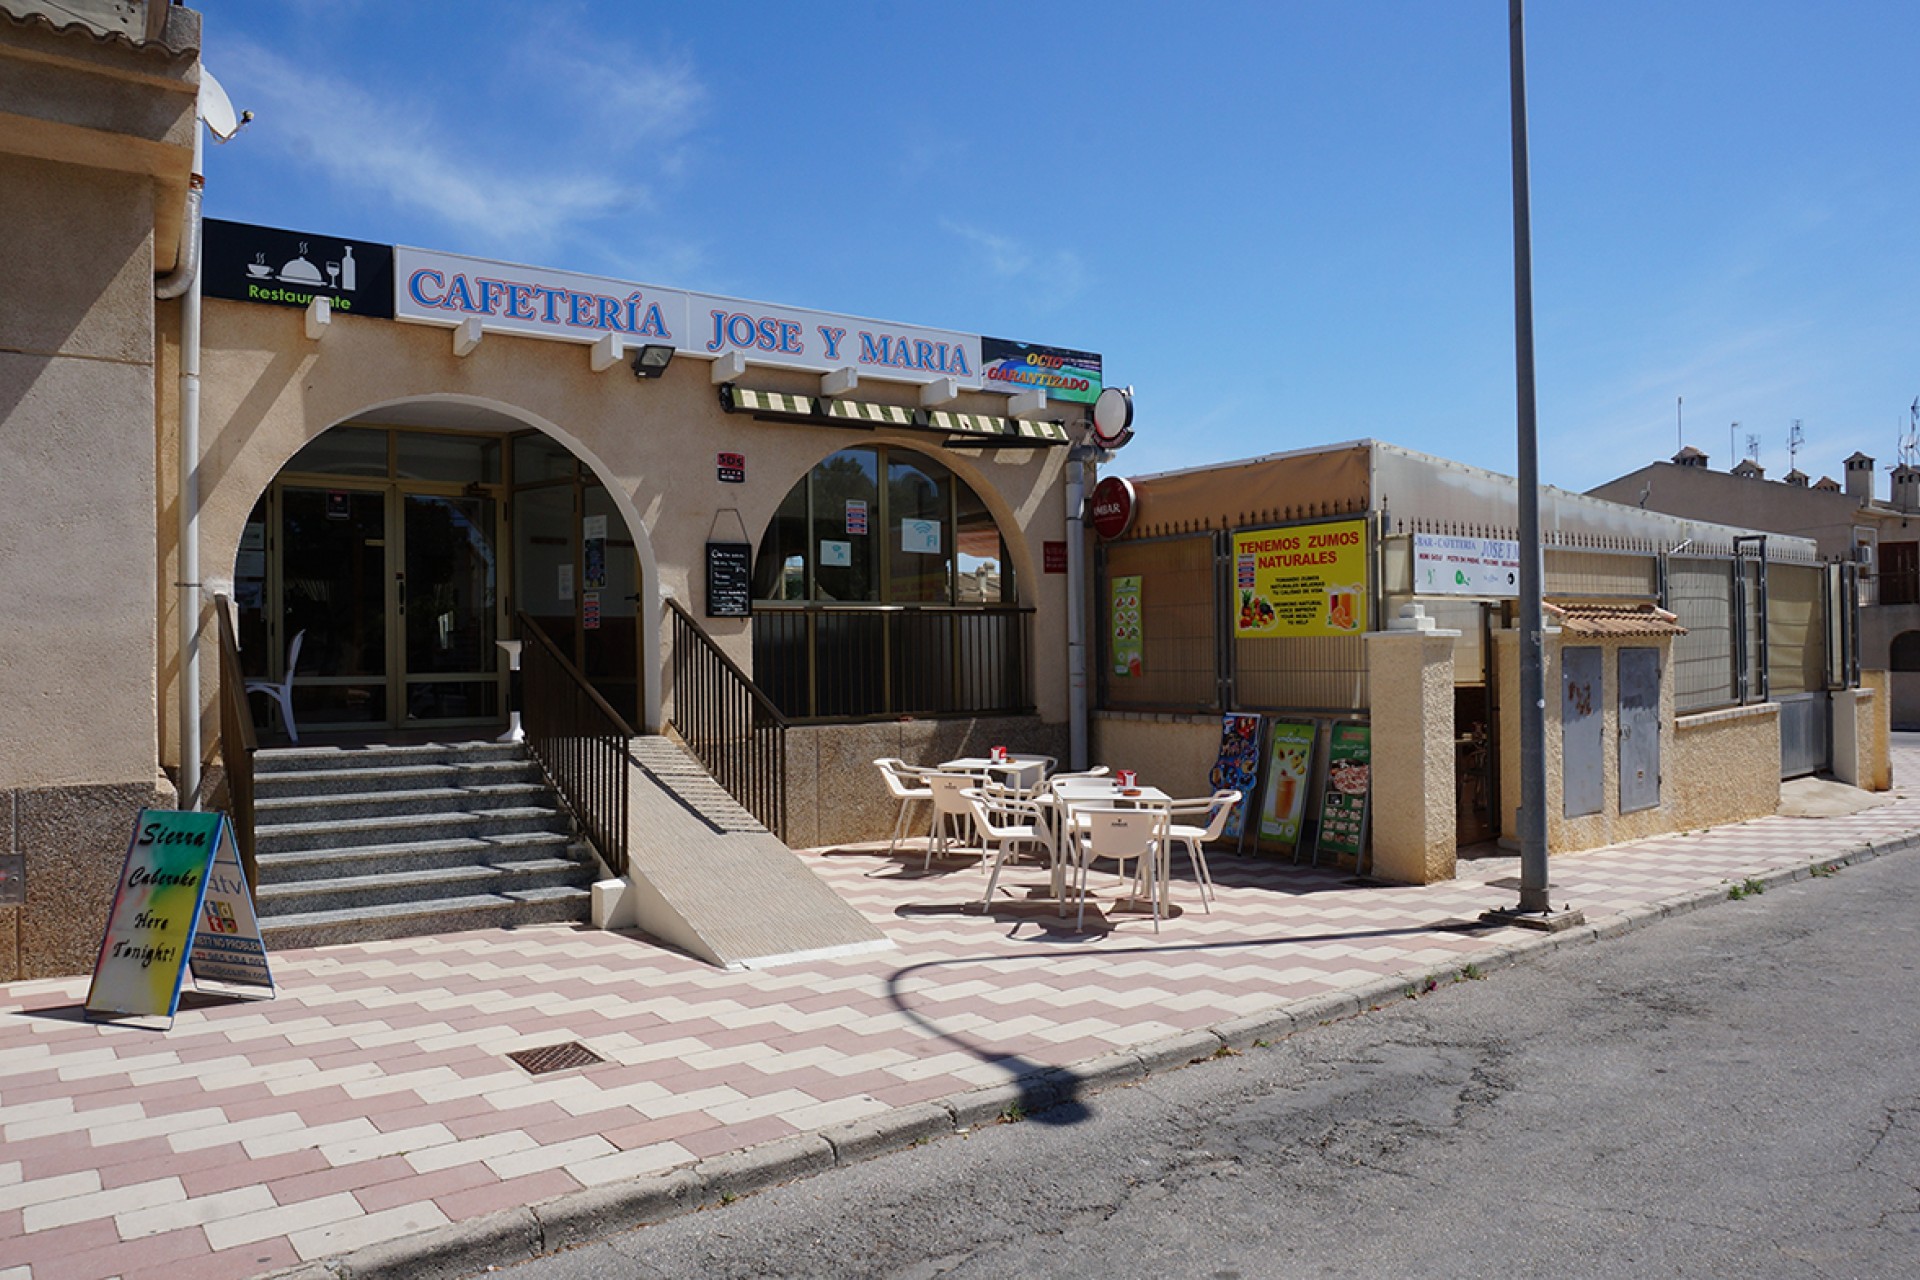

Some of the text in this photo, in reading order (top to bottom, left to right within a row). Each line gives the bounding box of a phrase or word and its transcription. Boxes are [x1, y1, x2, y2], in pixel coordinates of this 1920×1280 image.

[249, 284, 351, 310] Restaurnte
[409, 268, 972, 377] CAFETERÍA JOSE Y MARIA
[1026, 353, 1063, 369] OCIO
[988, 367, 1089, 391] GARANTIZADO
[1239, 531, 1359, 554] TENEMOS ZUMOS
[1258, 551, 1337, 569] NATURALES
[138, 823, 206, 846] Sierra
[134, 909, 169, 931] Here
[113, 940, 176, 968] Tonight!
